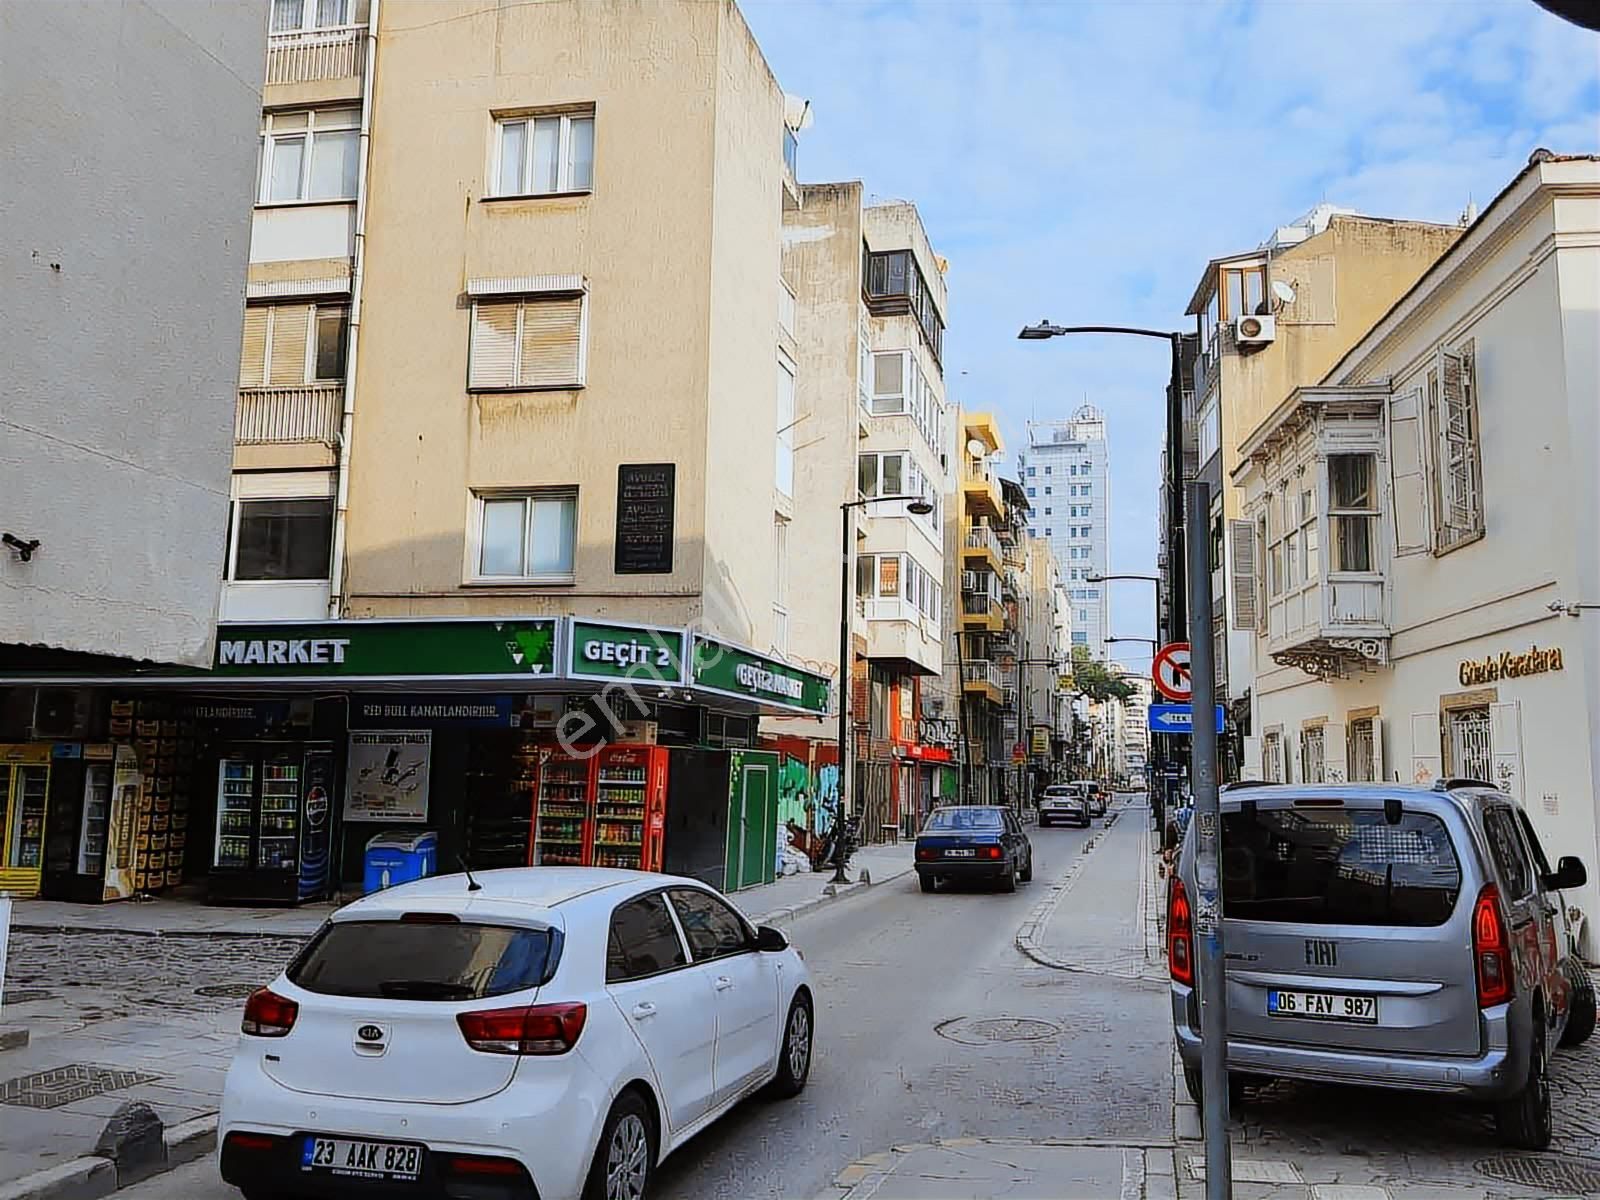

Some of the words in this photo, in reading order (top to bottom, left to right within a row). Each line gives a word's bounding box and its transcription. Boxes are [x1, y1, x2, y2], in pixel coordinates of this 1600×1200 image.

[219, 638, 350, 665] MARKET
[585, 639, 651, 667] GEÇİT
[656, 648, 670, 666] 2
[1304, 939, 1339, 966] FIAT
[1278, 993, 1297, 1011] 06
[1305, 995, 1333, 1014] FAV
[1344, 998, 1374, 1017] 987
[314, 1140, 336, 1165] 23
[346, 1143, 380, 1170] AAK
[384, 1147, 418, 1173] 828
